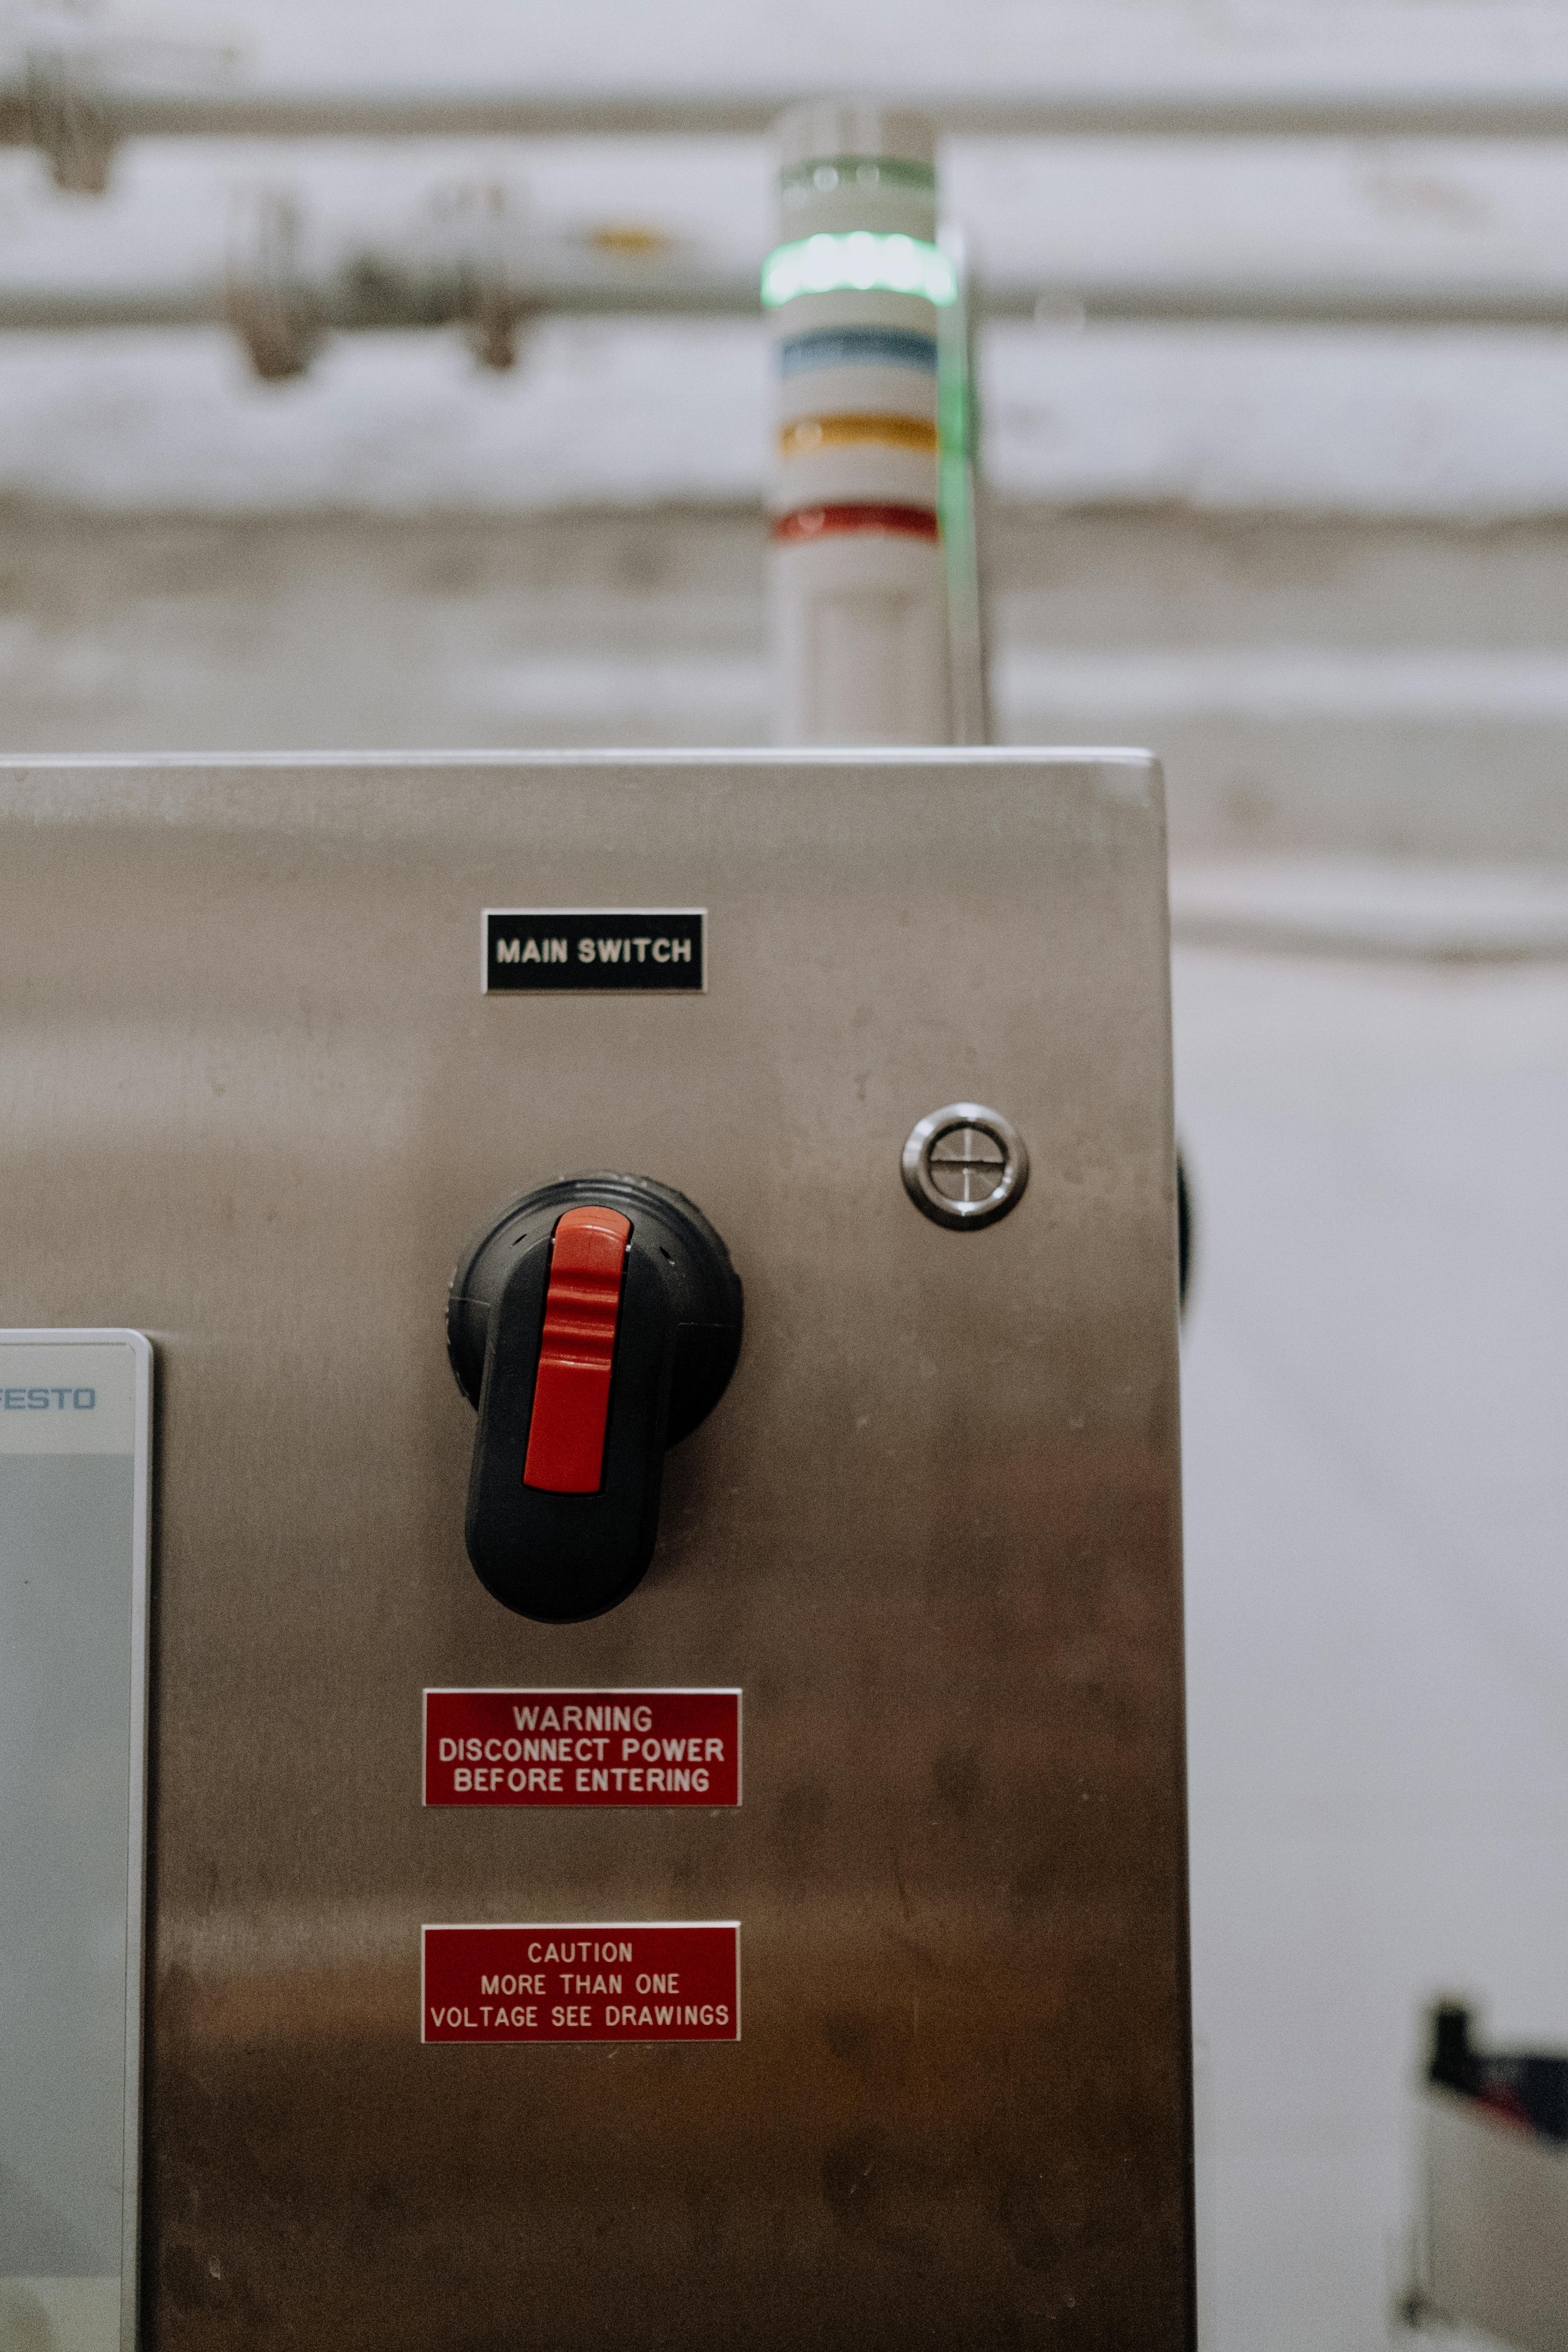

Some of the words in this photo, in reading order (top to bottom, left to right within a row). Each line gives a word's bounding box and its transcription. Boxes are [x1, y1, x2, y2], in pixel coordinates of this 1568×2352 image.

[497, 939, 568, 963] MAIN
[578, 938, 691, 963] SWITCH
[0, 1387, 96, 1409] ESTO
[514, 1706, 652, 1732] WARNING
[439, 1738, 609, 1762] DISCONNECT
[623, 1738, 724, 1762] POWER
[454, 1768, 563, 1792] BEFORE
[576, 1768, 709, 1792] ENTERING
[528, 1942, 633, 1963] CAUTION
[481, 1974, 546, 1995] MORE
[560, 1974, 622, 1994] THAN
[636, 1973, 679, 1994] ONE
[431, 2006, 538, 2027] VOLTAGE
[552, 2006, 592, 2027] SEE
[606, 2005, 729, 2026] DRAWINGS
